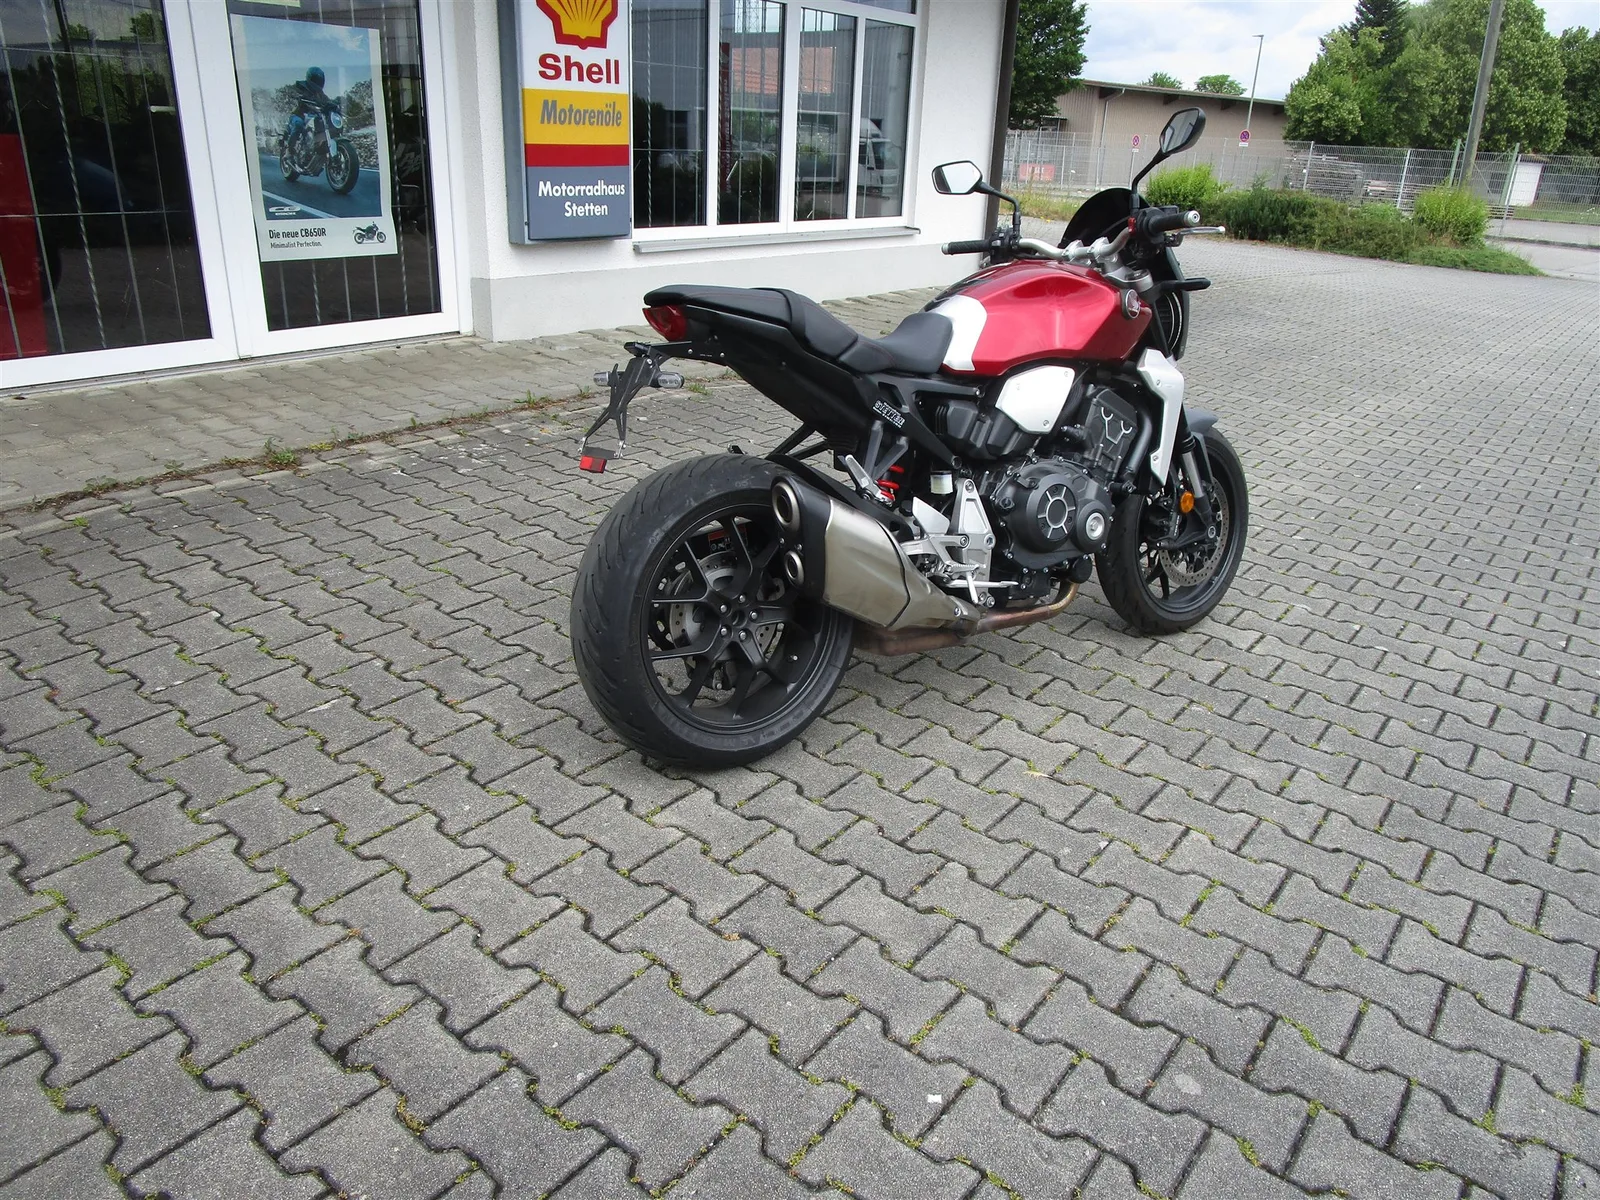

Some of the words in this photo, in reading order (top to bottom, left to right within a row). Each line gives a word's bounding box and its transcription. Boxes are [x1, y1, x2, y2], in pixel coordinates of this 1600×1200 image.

[538, 53, 620, 84] Shell
[540, 99, 622, 127] Motorenöle
[538, 180, 626, 197] Motorradhaus
[564, 201, 608, 217] Stetten
[268, 229, 280, 239] Die
[282, 230, 299, 239] neue
[300, 227, 327, 238] CB650R
[270, 241, 296, 249] Minimalist
